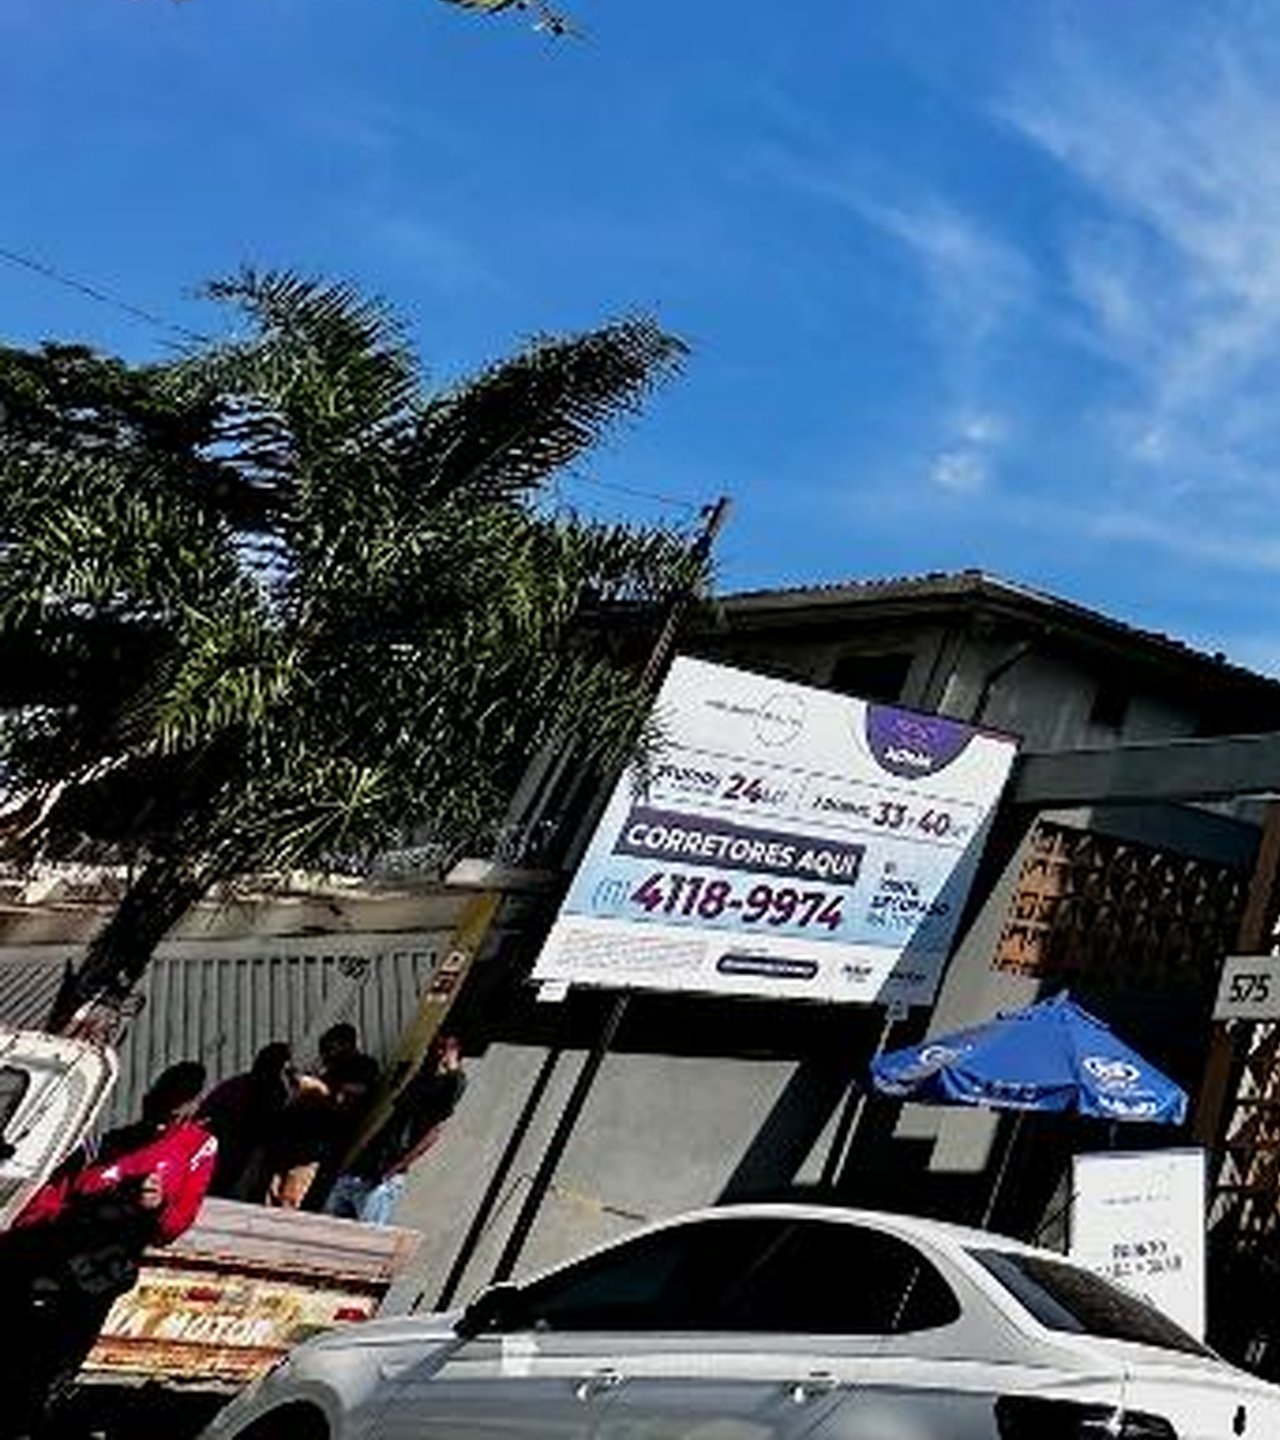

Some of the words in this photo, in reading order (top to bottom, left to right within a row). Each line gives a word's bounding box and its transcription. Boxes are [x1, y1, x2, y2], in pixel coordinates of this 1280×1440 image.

[721, 772, 763, 803] 24
[873, 801, 909, 829] 33
[918, 809, 950, 837] 40
[627, 823, 796, 867] CORRETORES
[795, 849, 857, 878] AQUI
[629, 871, 845, 931] 4118-9974
[1230, 973, 1273, 1003] 575
